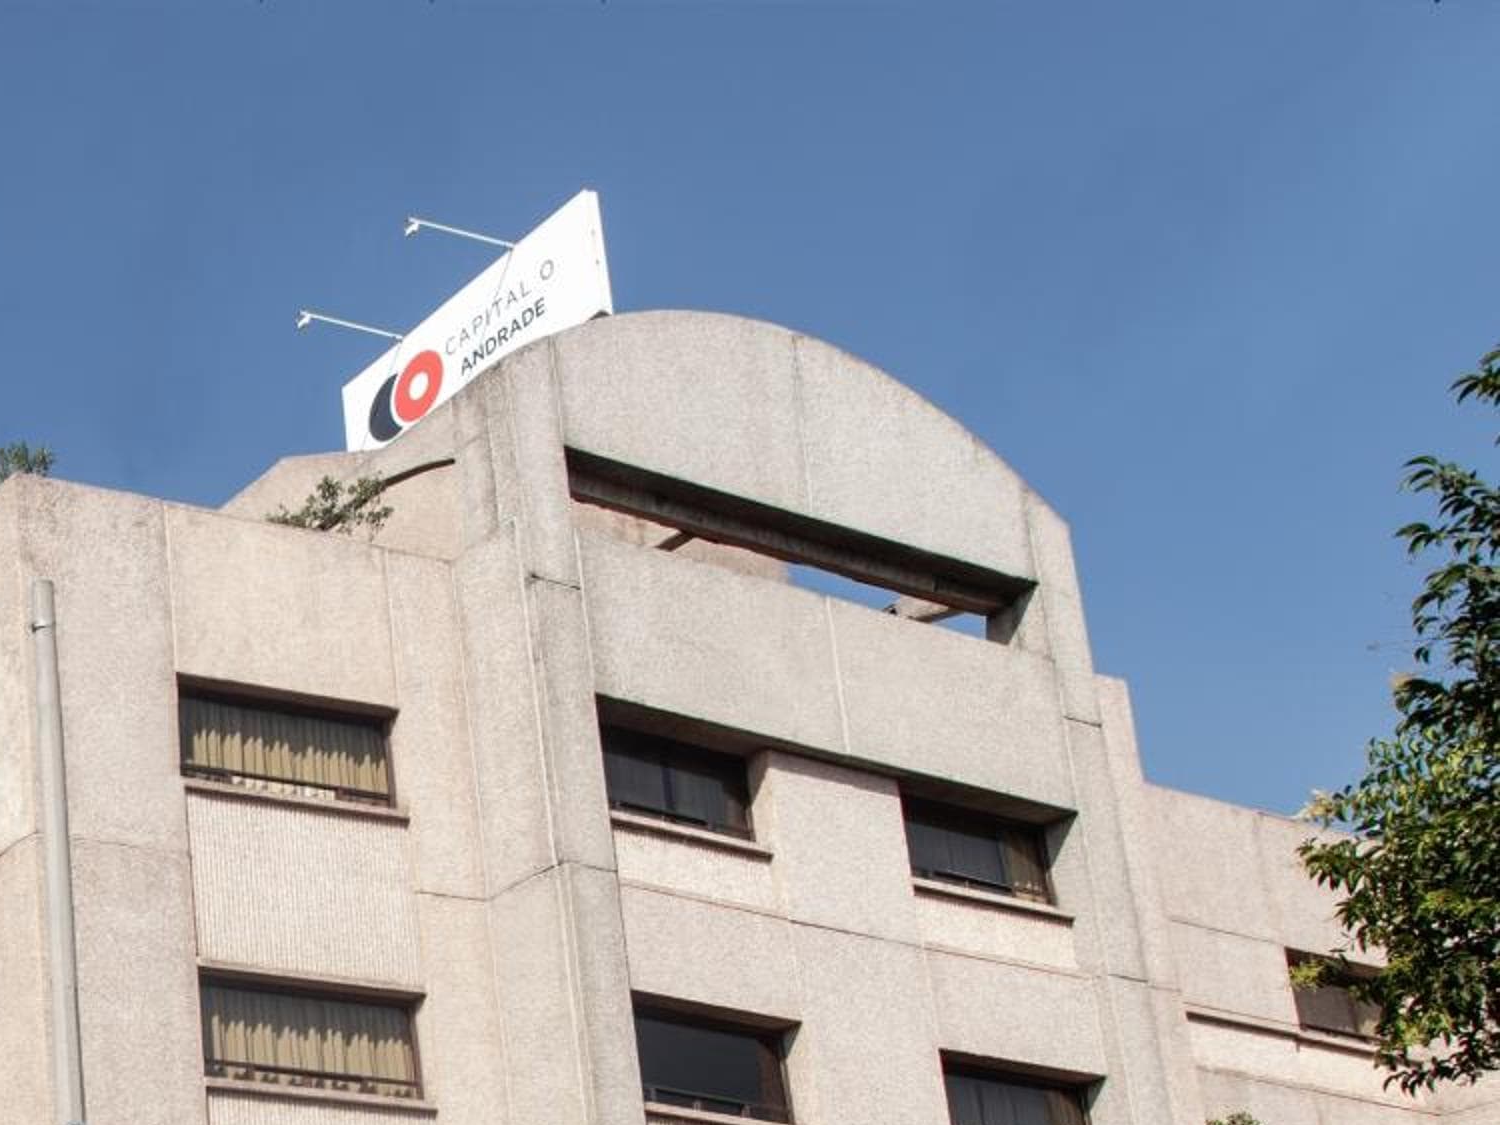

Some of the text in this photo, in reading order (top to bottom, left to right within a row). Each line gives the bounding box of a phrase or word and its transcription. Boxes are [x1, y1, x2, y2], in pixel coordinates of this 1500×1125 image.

[445, 259, 555, 355] CAPITAL O
[461, 297, 546, 376] ANDRADE
